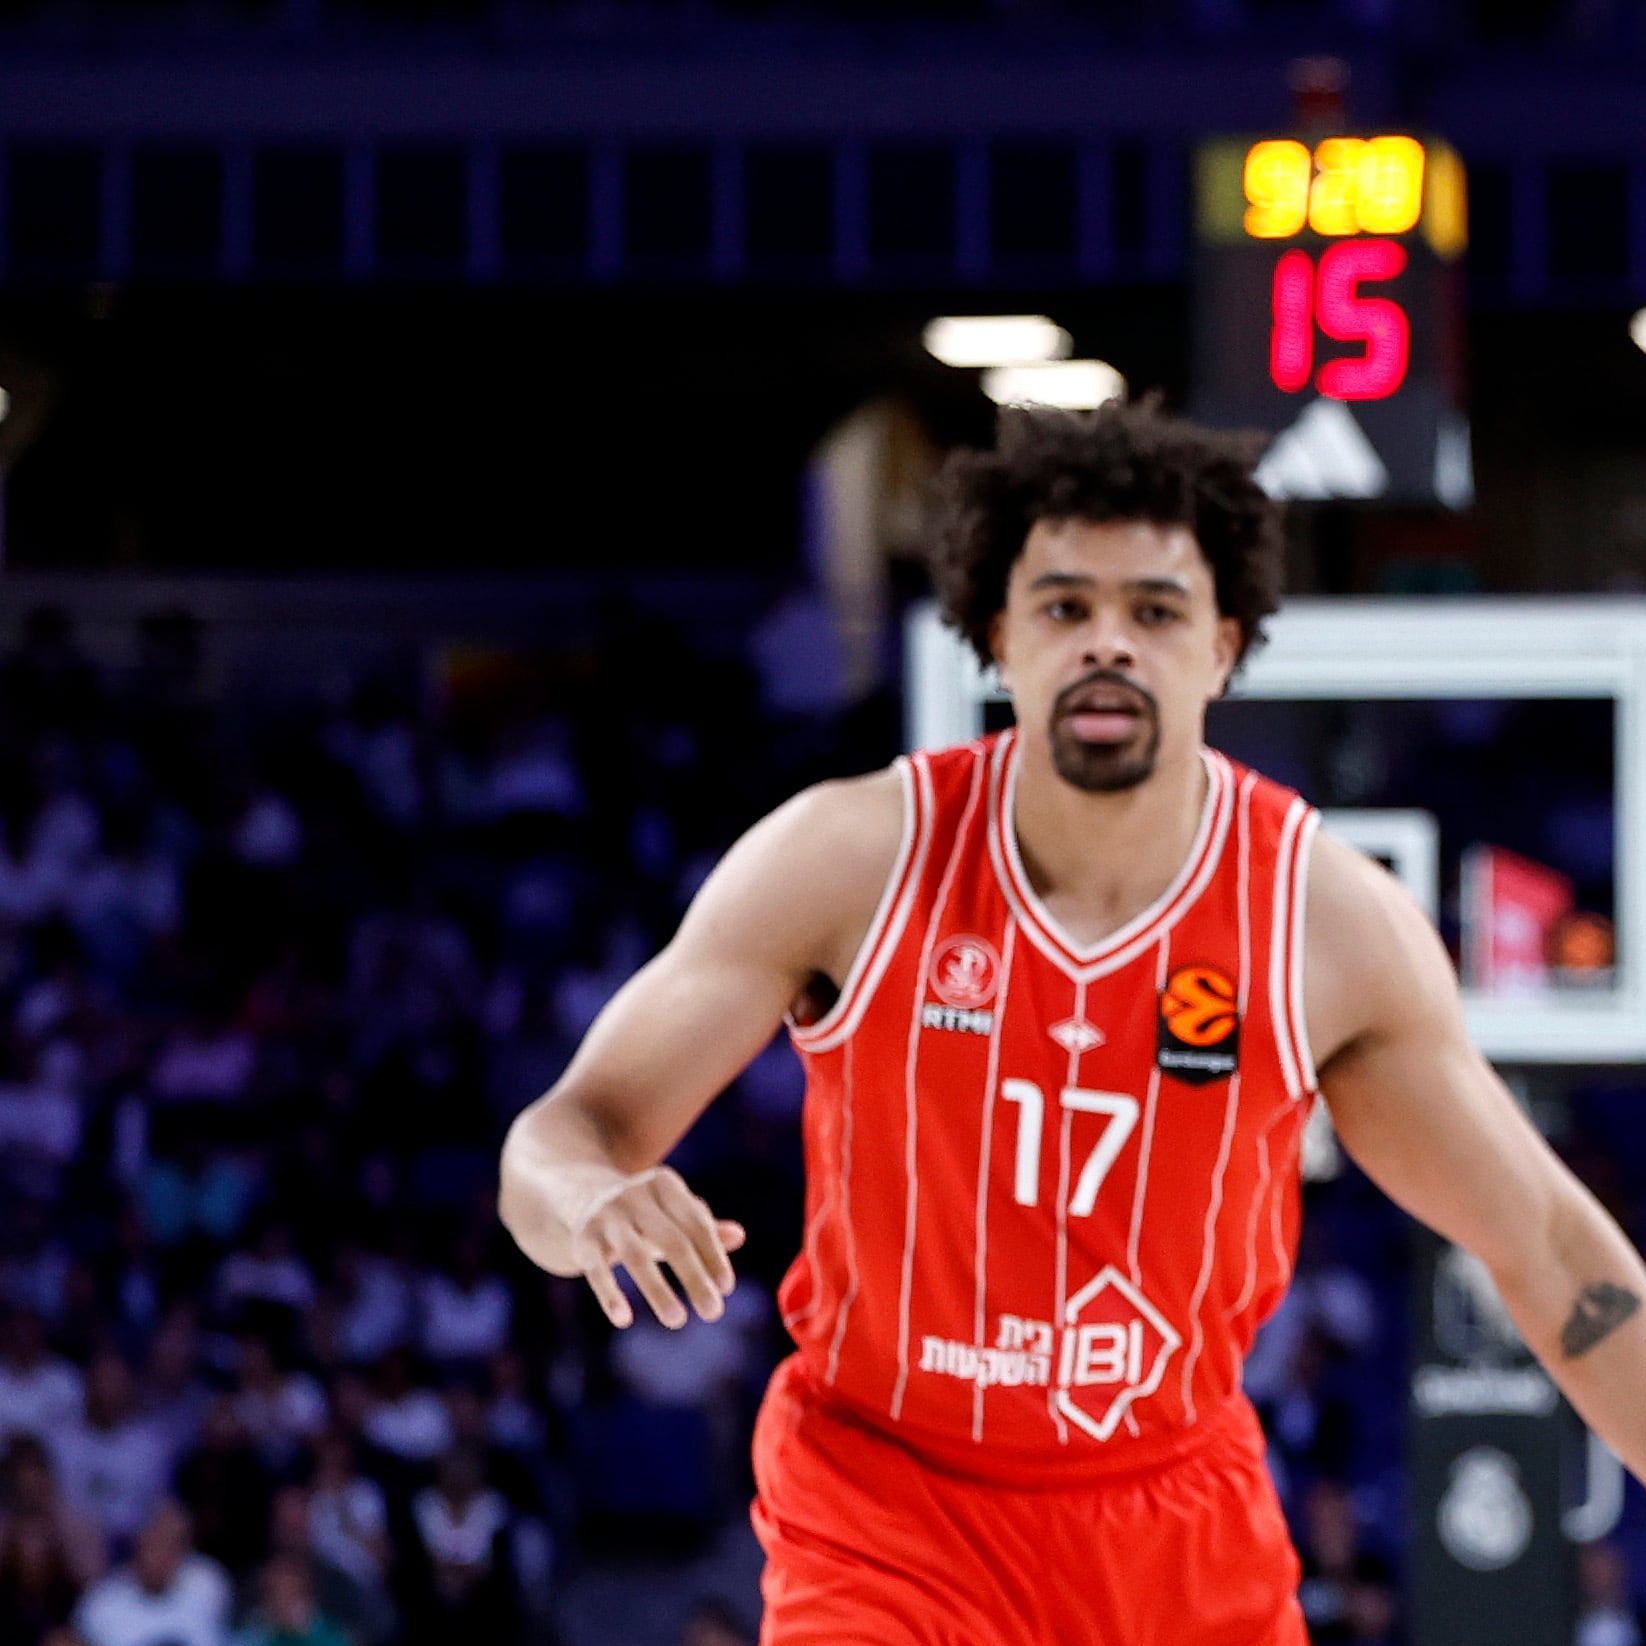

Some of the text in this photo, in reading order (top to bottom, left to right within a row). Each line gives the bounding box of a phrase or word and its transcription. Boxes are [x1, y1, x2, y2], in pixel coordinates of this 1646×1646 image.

[1270, 239, 1410, 400] 15
[1001, 1077, 1141, 1218] 17
[1057, 1318, 1143, 1387] IBI
